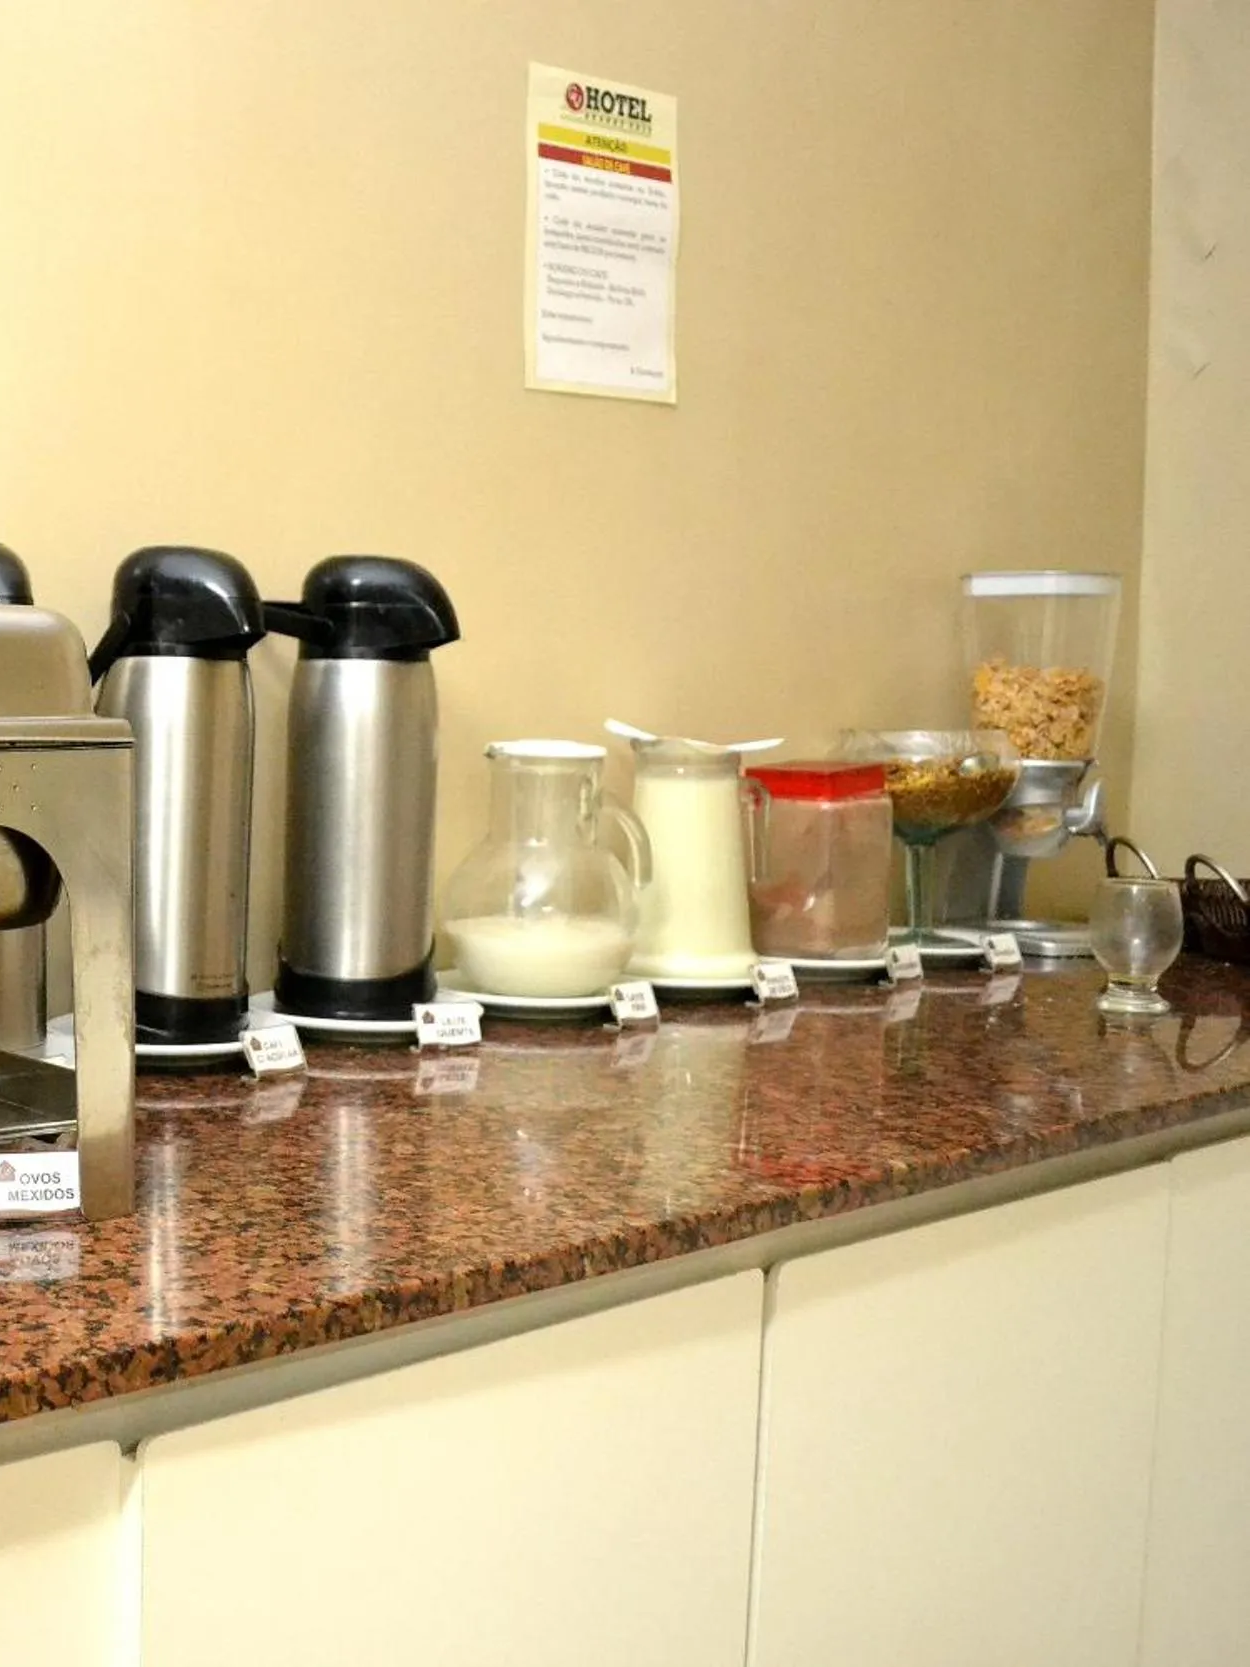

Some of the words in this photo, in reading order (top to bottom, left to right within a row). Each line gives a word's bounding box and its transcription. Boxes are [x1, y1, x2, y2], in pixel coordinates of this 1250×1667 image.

[585, 86, 652, 122] HOTEL
[19, 1172, 61, 1186] OVOS
[7, 1188, 75, 1202] MEXIDOS
